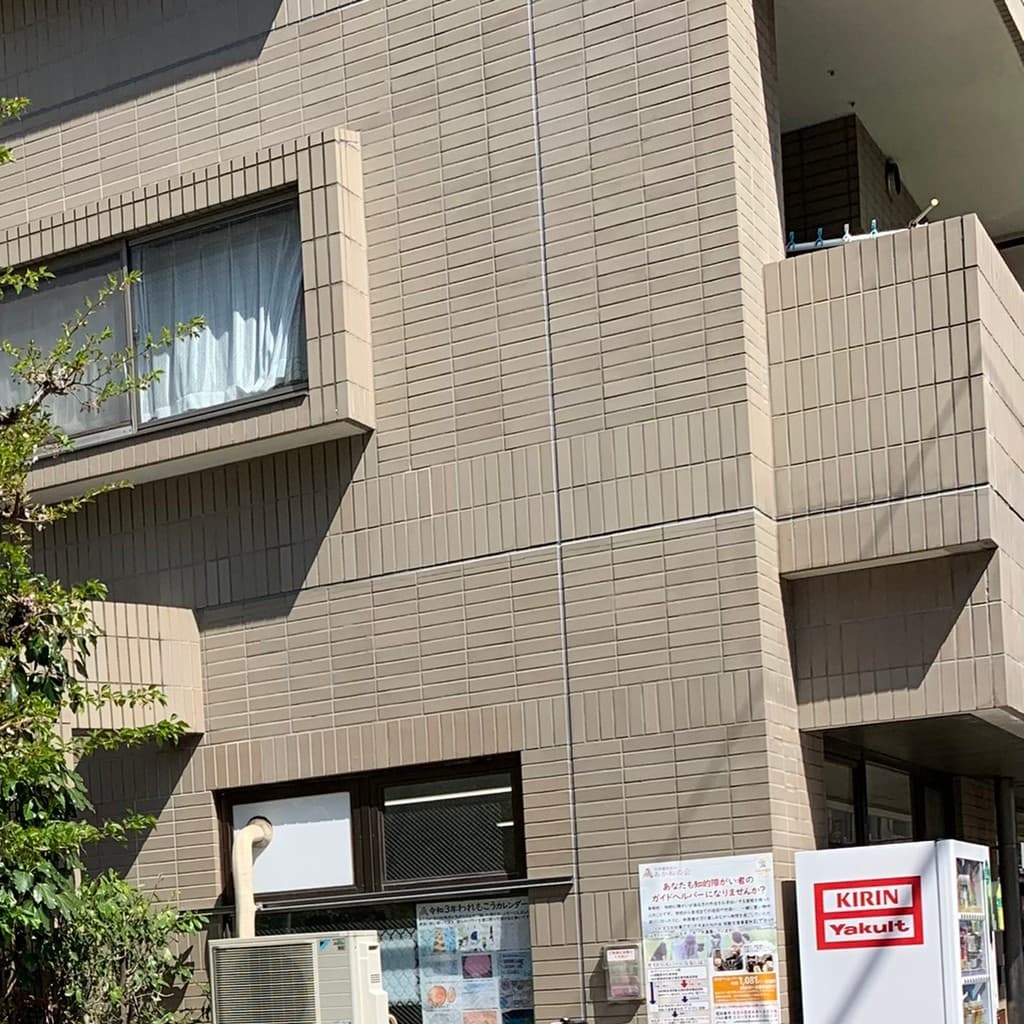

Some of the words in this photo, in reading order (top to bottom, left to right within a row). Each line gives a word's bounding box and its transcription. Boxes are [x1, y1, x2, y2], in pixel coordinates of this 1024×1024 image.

[662, 876, 754, 891] あなたも知的障がい者の
[836, 888, 899, 908] KIRIN
[429, 899, 529, 915] 令和3年われもこうカレンダー
[830, 920, 910, 936] Yakult
